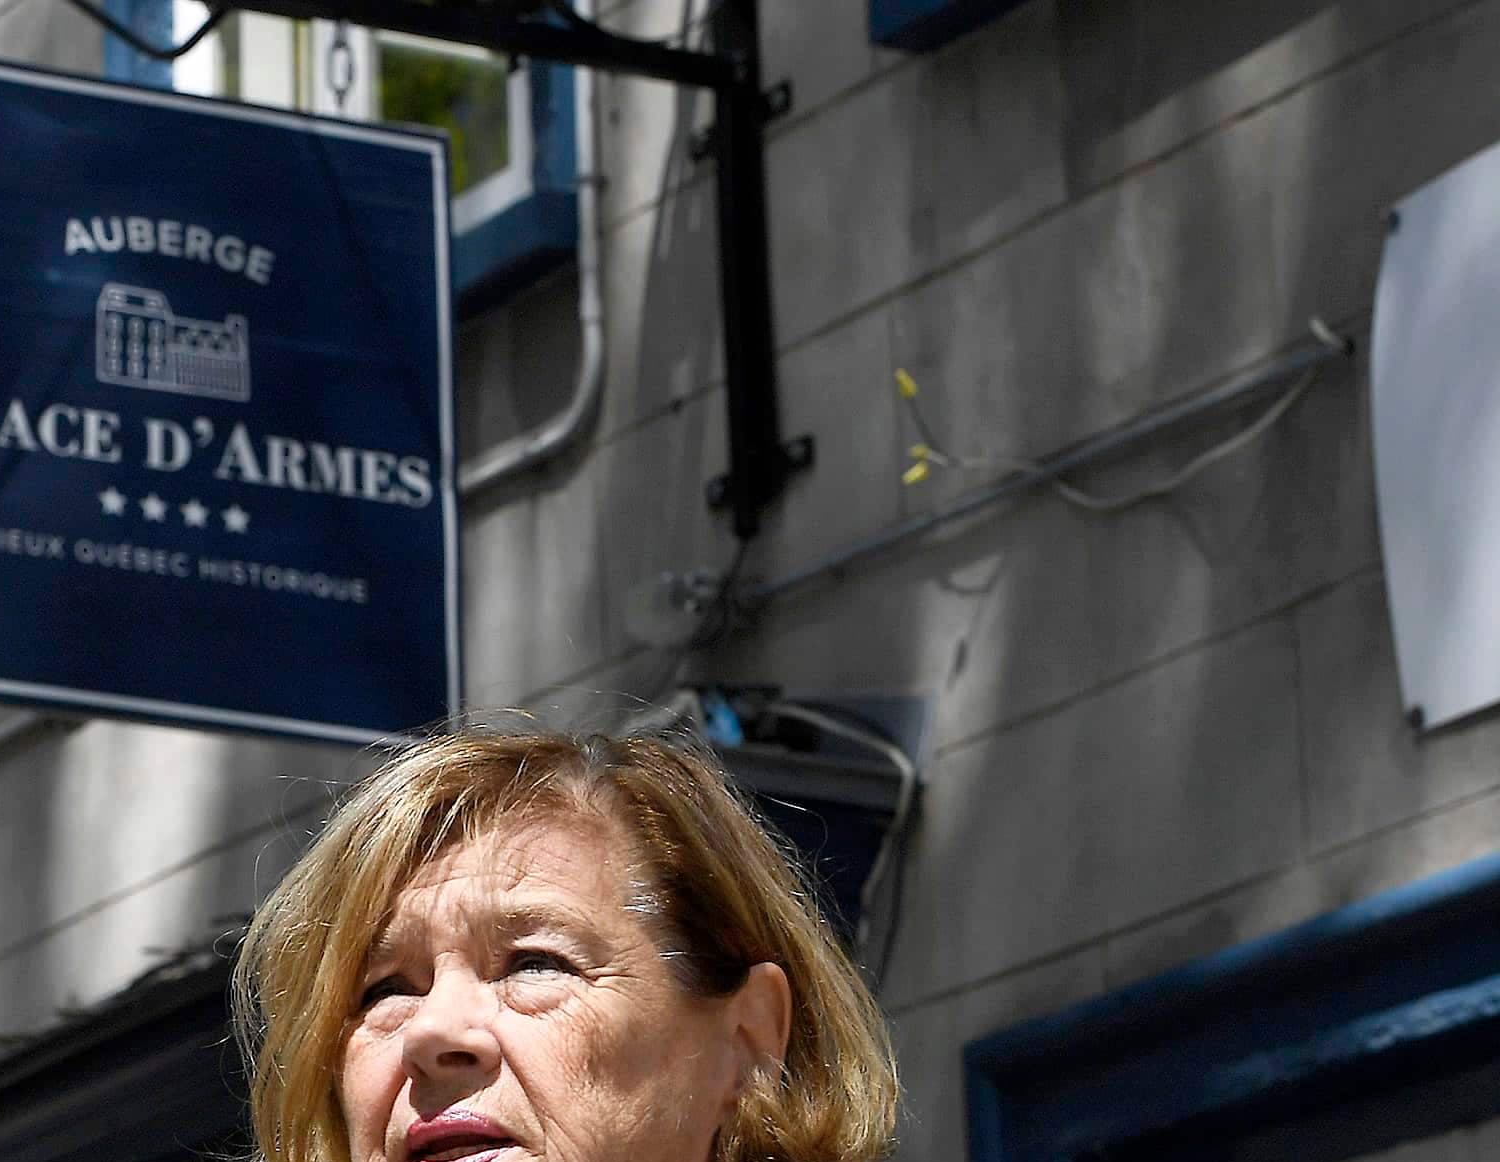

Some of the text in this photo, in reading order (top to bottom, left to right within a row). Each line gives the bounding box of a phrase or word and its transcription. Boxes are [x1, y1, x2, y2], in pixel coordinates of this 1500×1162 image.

[64, 215, 277, 285] AUBERGE
[74, 534, 191, 579] QUÉBEC
[199, 559, 369, 604] HISTORIQUE
